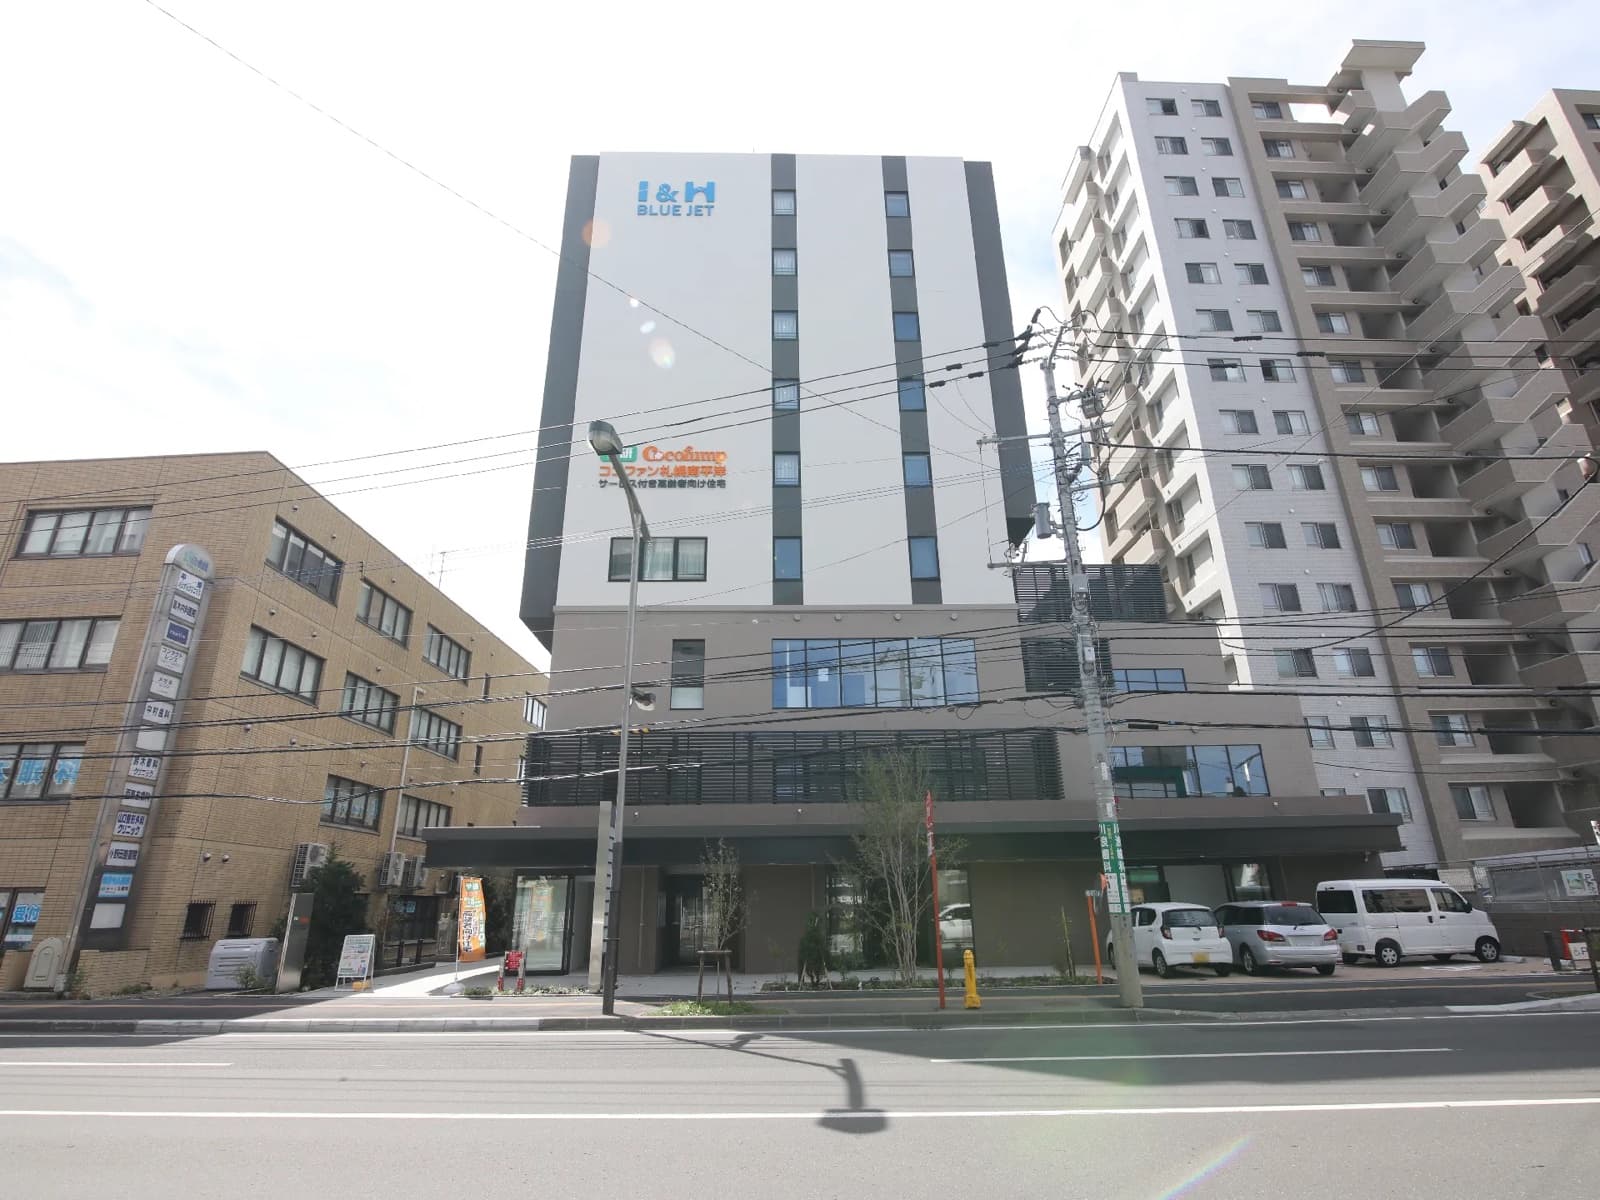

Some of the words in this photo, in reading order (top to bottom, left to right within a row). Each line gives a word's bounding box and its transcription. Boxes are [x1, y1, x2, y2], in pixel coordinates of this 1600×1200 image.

[638, 181, 648, 202] I
[656, 183, 680, 203] &
[685, 181, 715, 203] H
[637, 204, 682, 217] BLUE
[686, 204, 715, 217] JET
[599, 465, 727, 478] コファン札幌南平岸
[116, 824, 141, 836] クリニック
[12, 905, 41, 923] 受付
